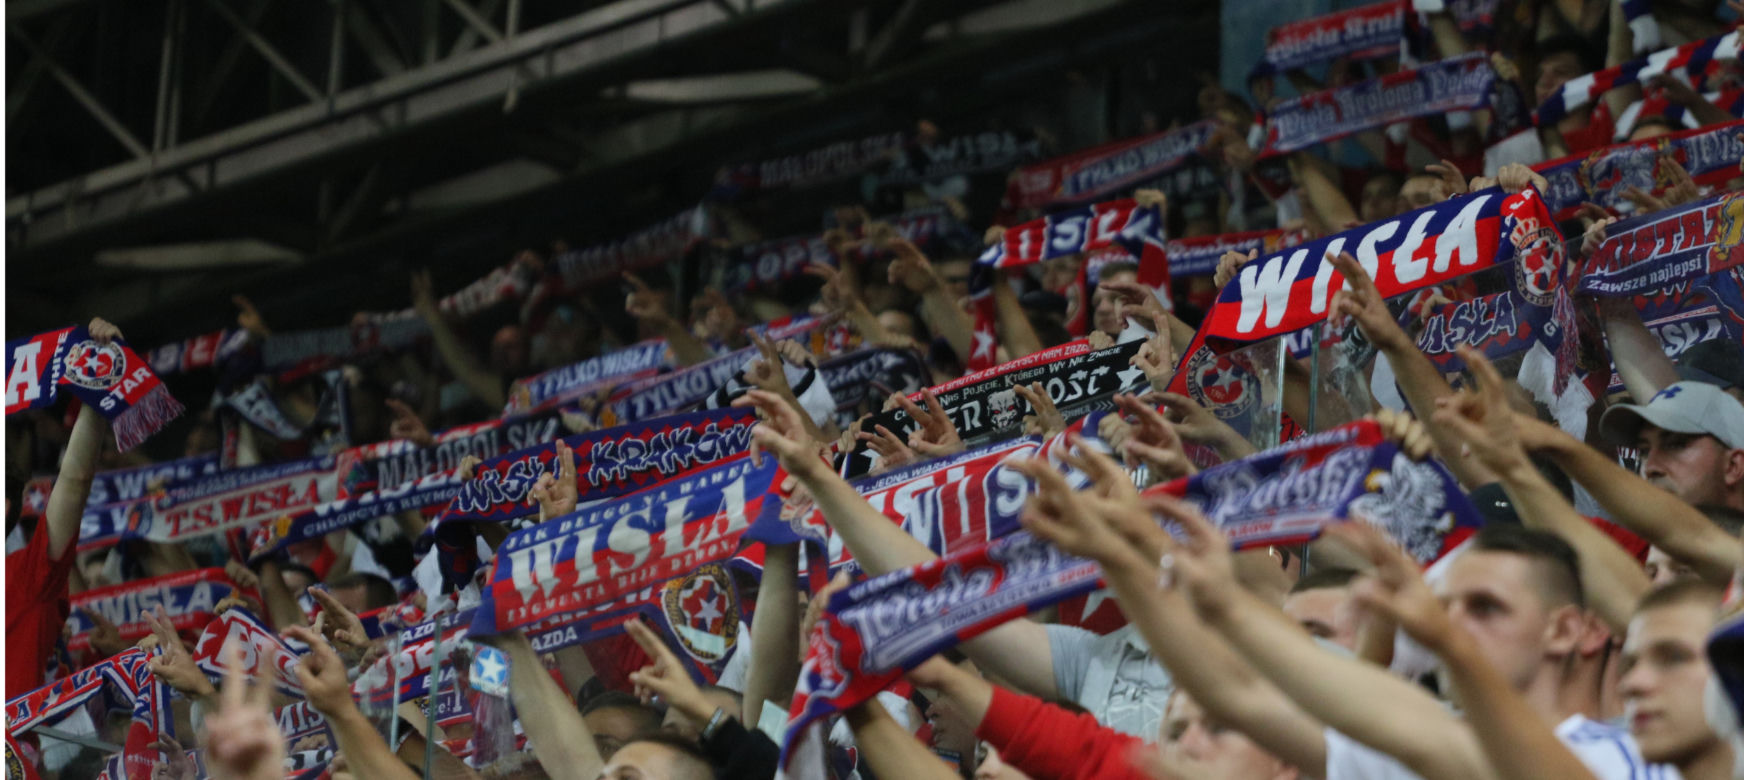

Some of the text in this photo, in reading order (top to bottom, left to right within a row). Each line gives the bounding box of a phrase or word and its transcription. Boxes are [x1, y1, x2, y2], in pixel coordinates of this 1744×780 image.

[1235, 194, 1493, 334] WISŁA
[1586, 273, 1648, 293] Zawsze
[1649, 254, 1703, 284] najlepsi
[100, 366, 151, 411] STAR
[220, 479, 321, 523] WISŁA
[400, 487, 461, 511] REYMO
[872, 471, 909, 490] JEDNA
[505, 527, 548, 551] JAK
[507, 472, 751, 606] WISŁA
